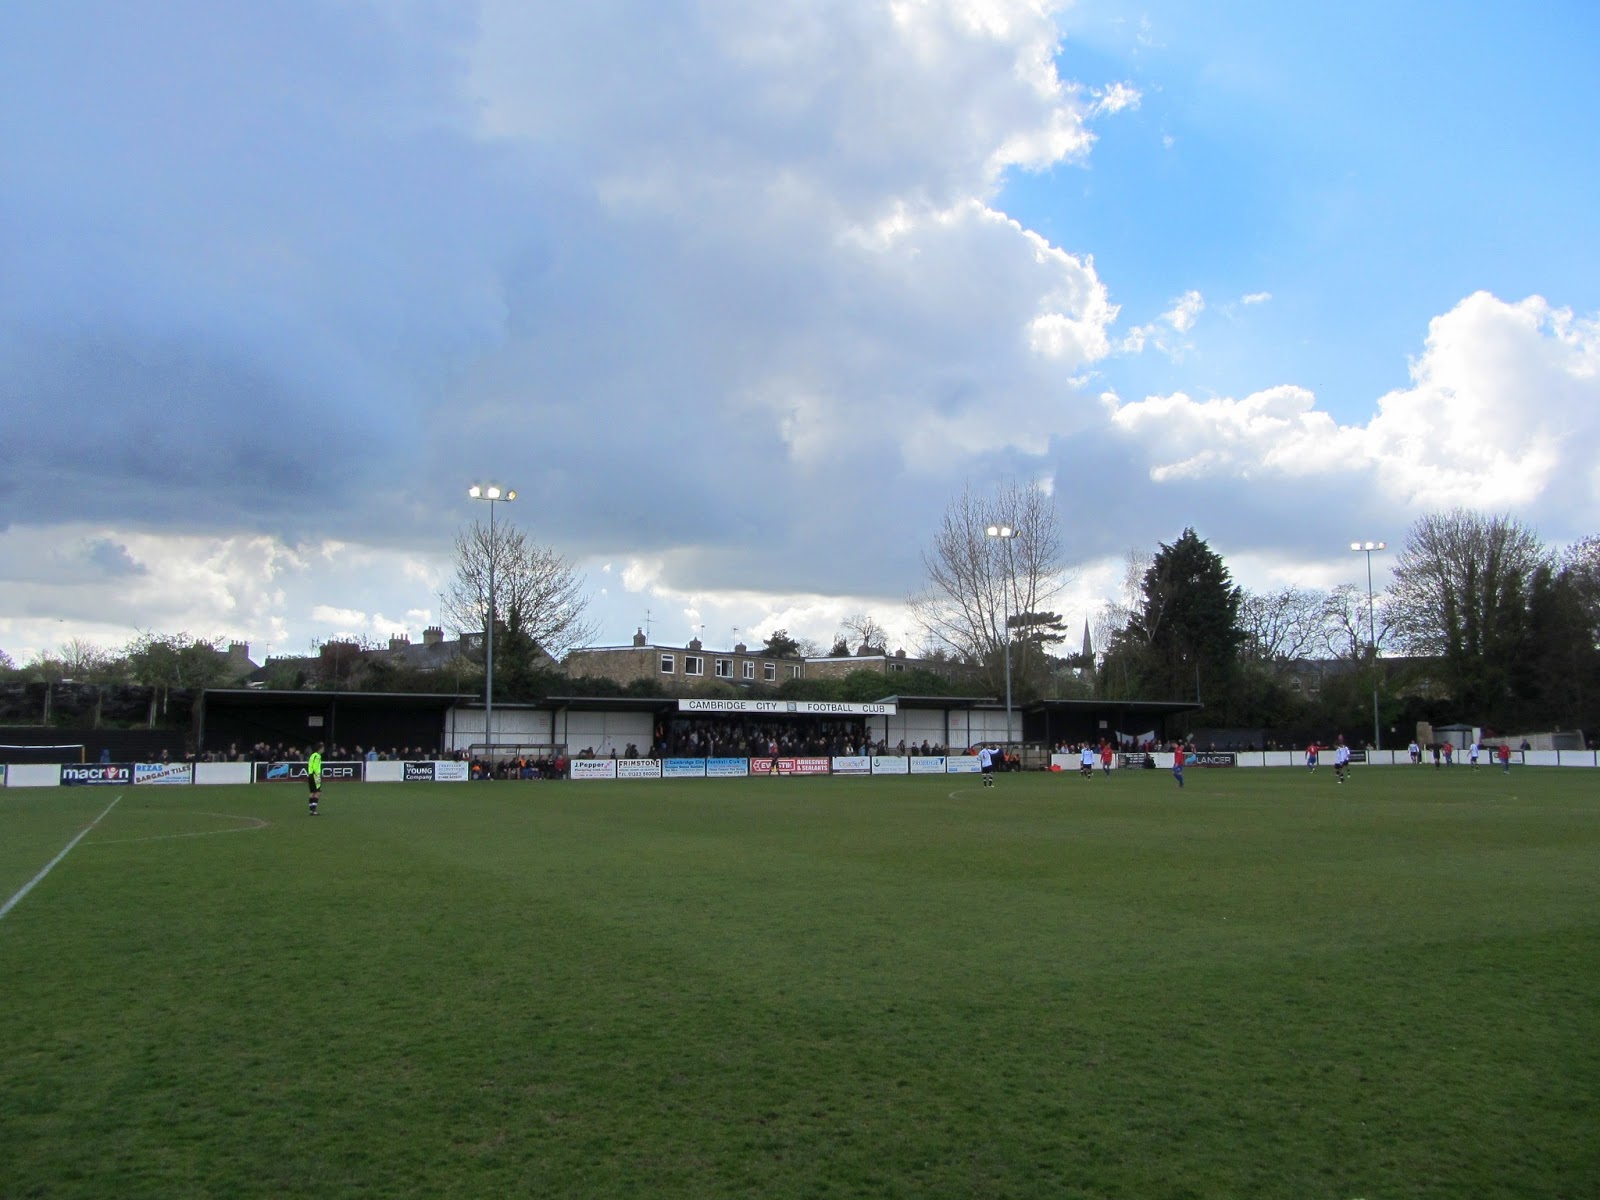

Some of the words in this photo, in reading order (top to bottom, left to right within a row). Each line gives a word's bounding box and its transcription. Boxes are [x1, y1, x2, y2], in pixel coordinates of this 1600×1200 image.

[689, 701, 746, 709] CAMBRIDGE
[808, 703, 853, 712] FOOTBALL
[863, 705, 885, 713] CLUB
[619, 760, 660, 768] FRIMSTONE
[136, 770, 170, 783] BARGAIN
[171, 765, 191, 774] TILES
[290, 768, 353, 777] LACER
